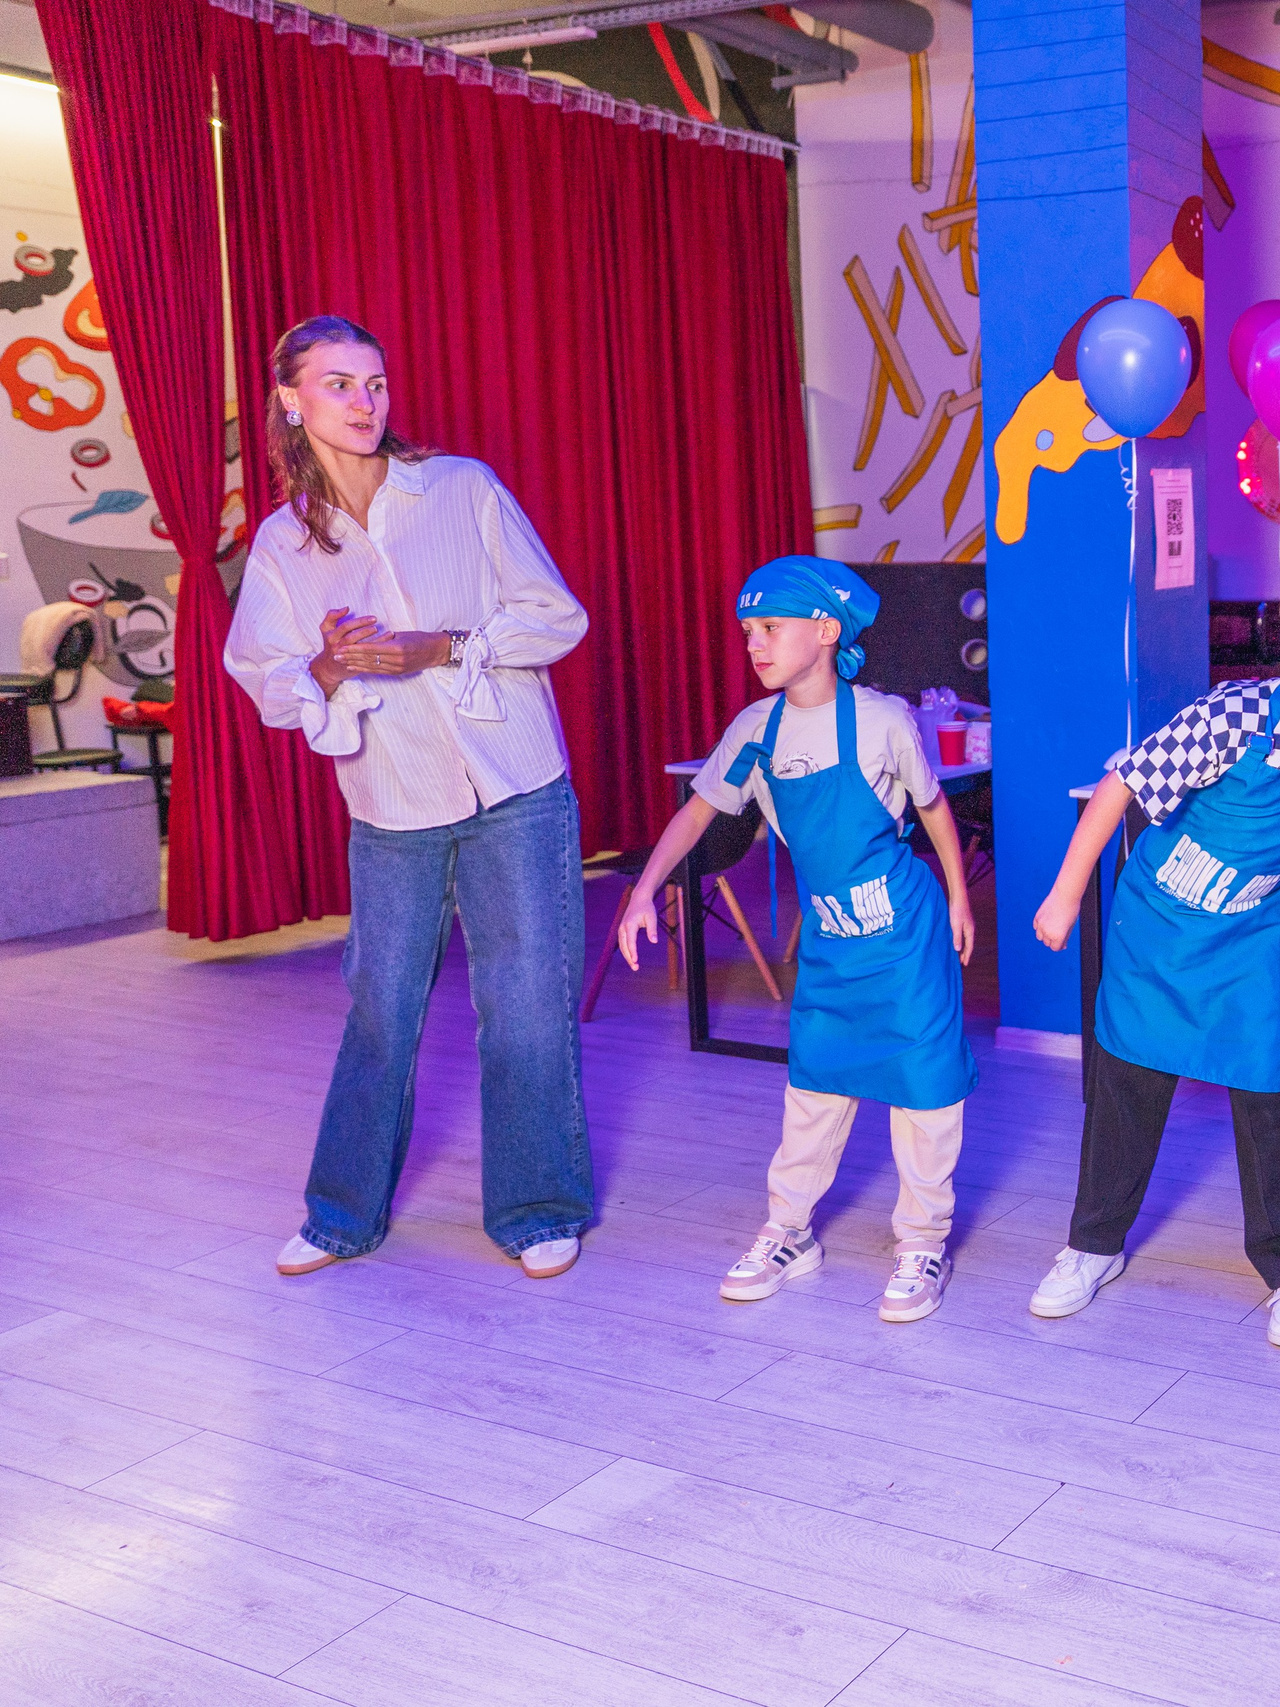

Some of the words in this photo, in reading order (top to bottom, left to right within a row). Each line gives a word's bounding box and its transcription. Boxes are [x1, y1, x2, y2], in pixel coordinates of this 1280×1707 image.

[823, 895, 861, 937] &
[849, 874, 895, 936] RUN
[1156, 833, 1224, 905] COOK
[1201, 866, 1238, 913] &
